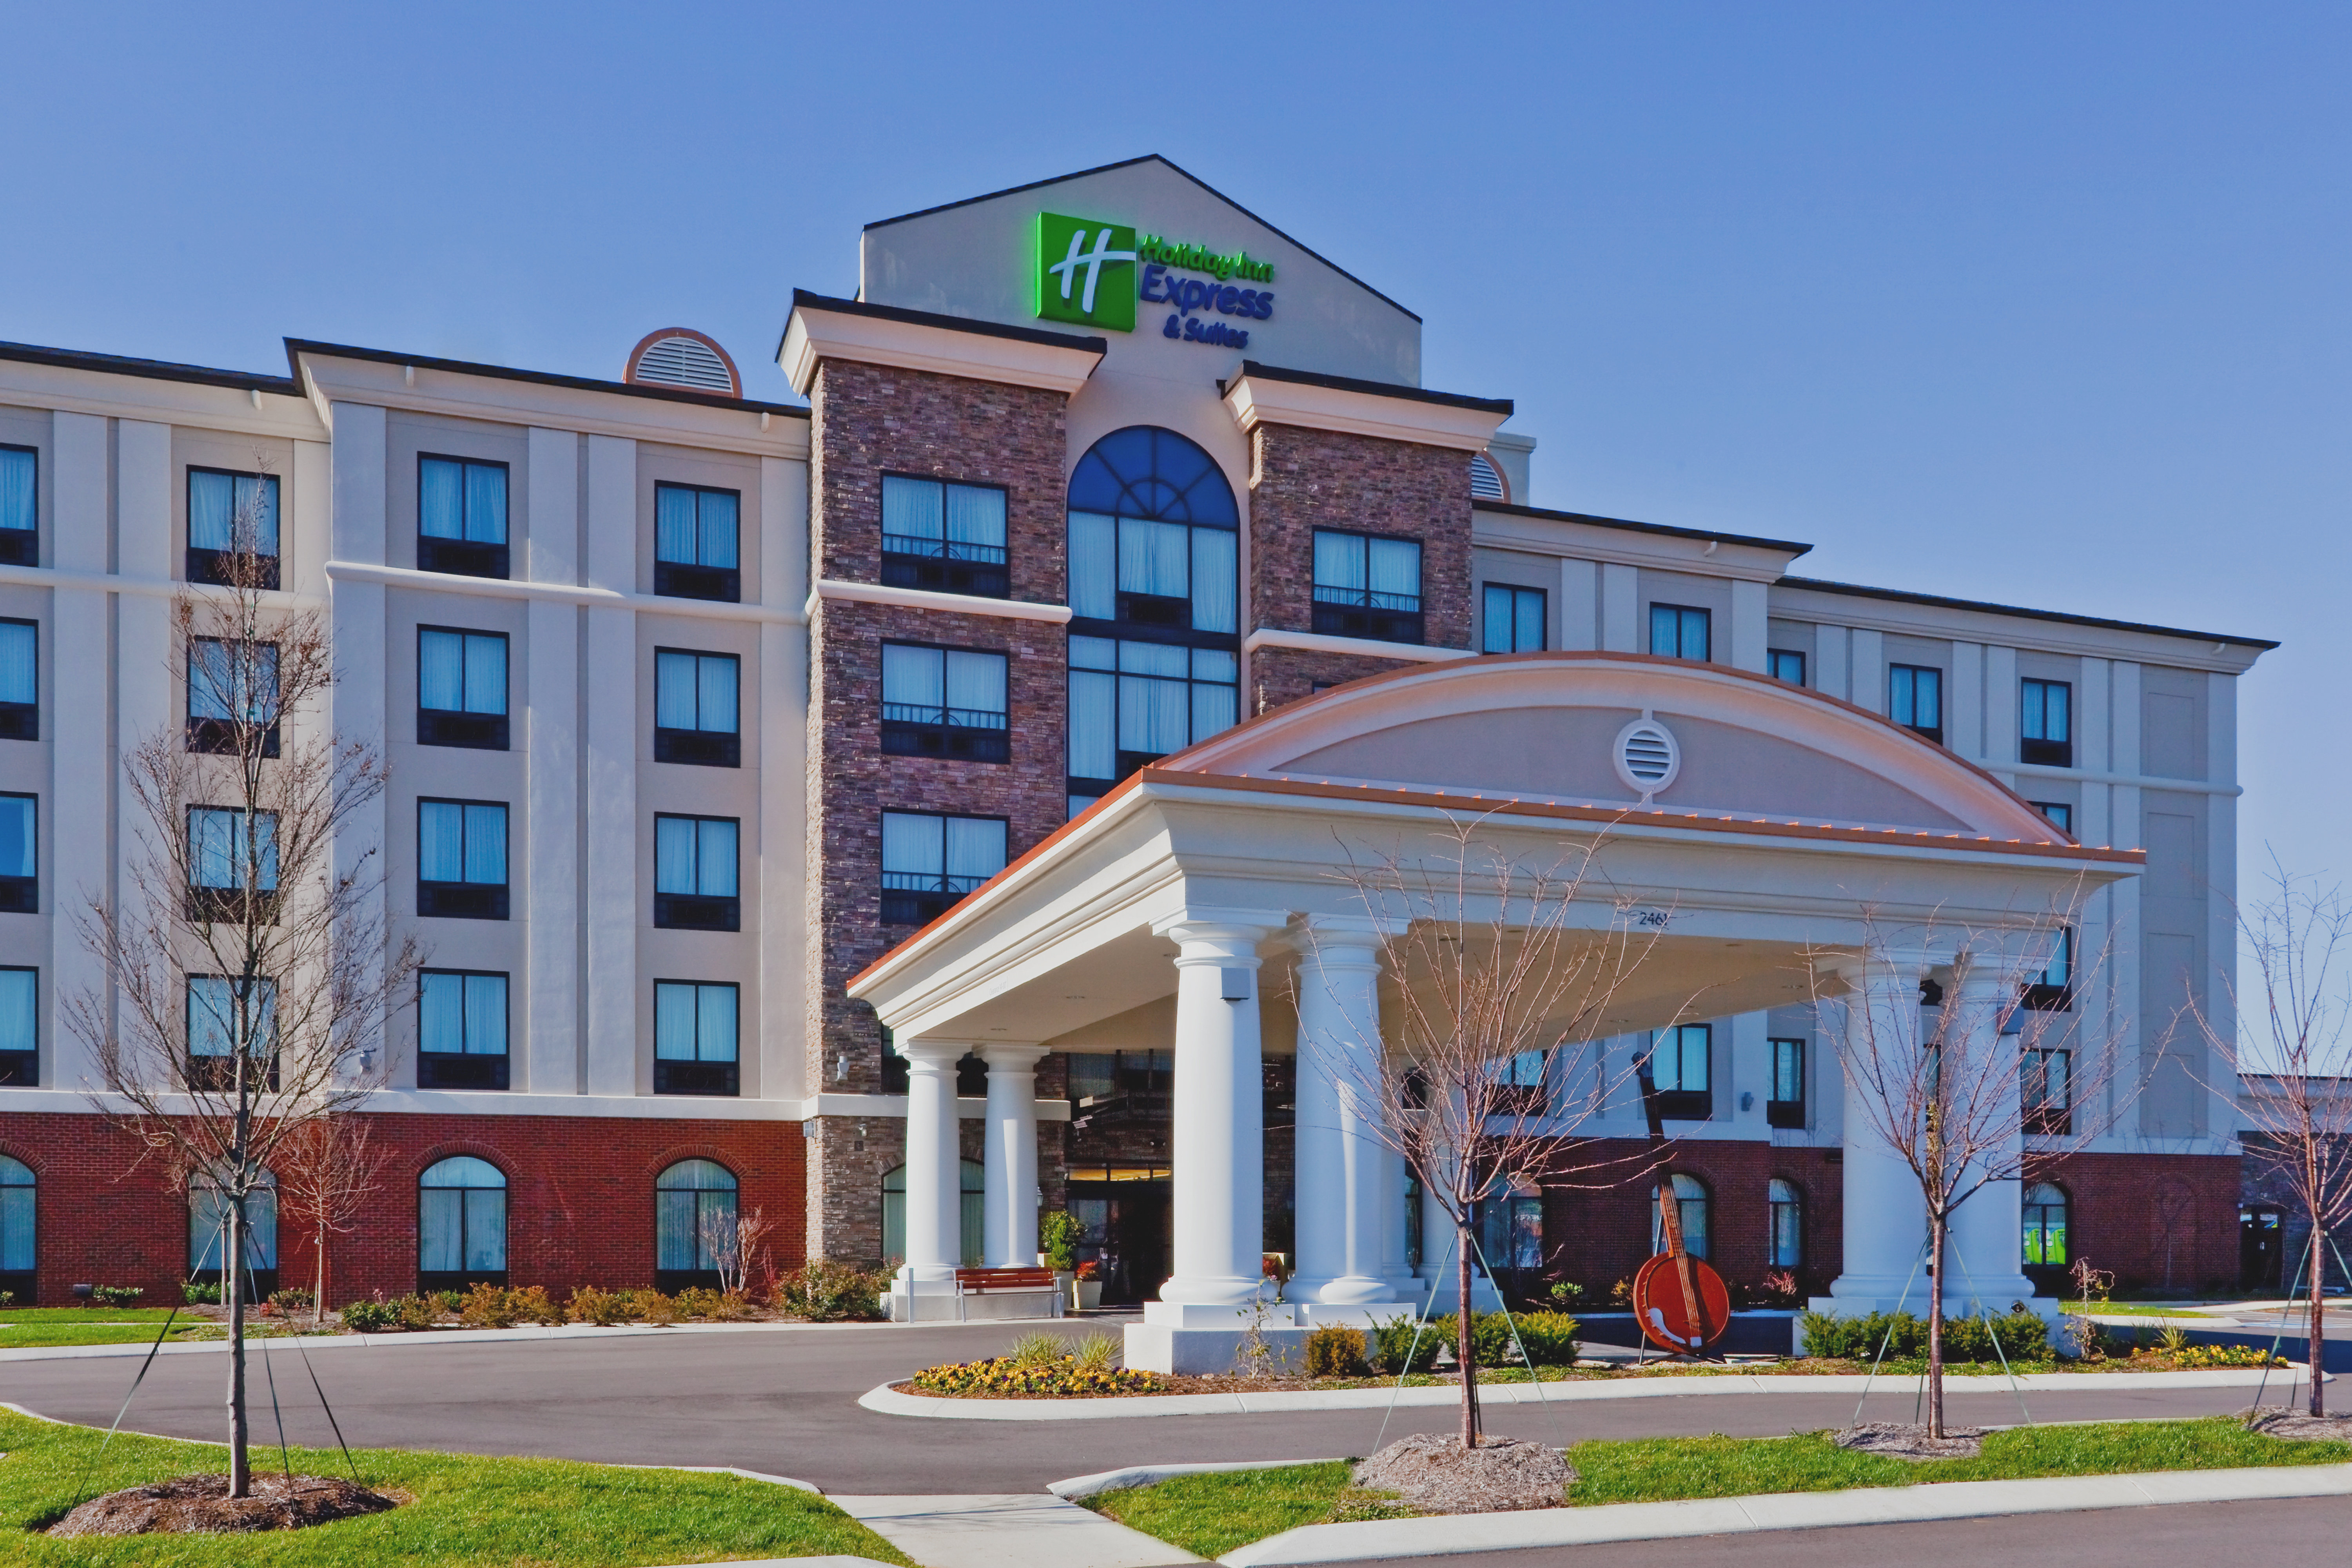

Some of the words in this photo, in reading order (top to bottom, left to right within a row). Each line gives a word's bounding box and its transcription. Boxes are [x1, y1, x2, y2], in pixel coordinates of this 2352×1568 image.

[1049, 229, 1136, 313] H
[1140, 234, 1234, 281] Holiday
[1236, 251, 1274, 283] Inn
[1140, 264, 1274, 319] Express
[1163, 314, 1181, 339] &
[1183, 318, 1249, 349] Suites
[1639, 912, 1667, 926] 2461
